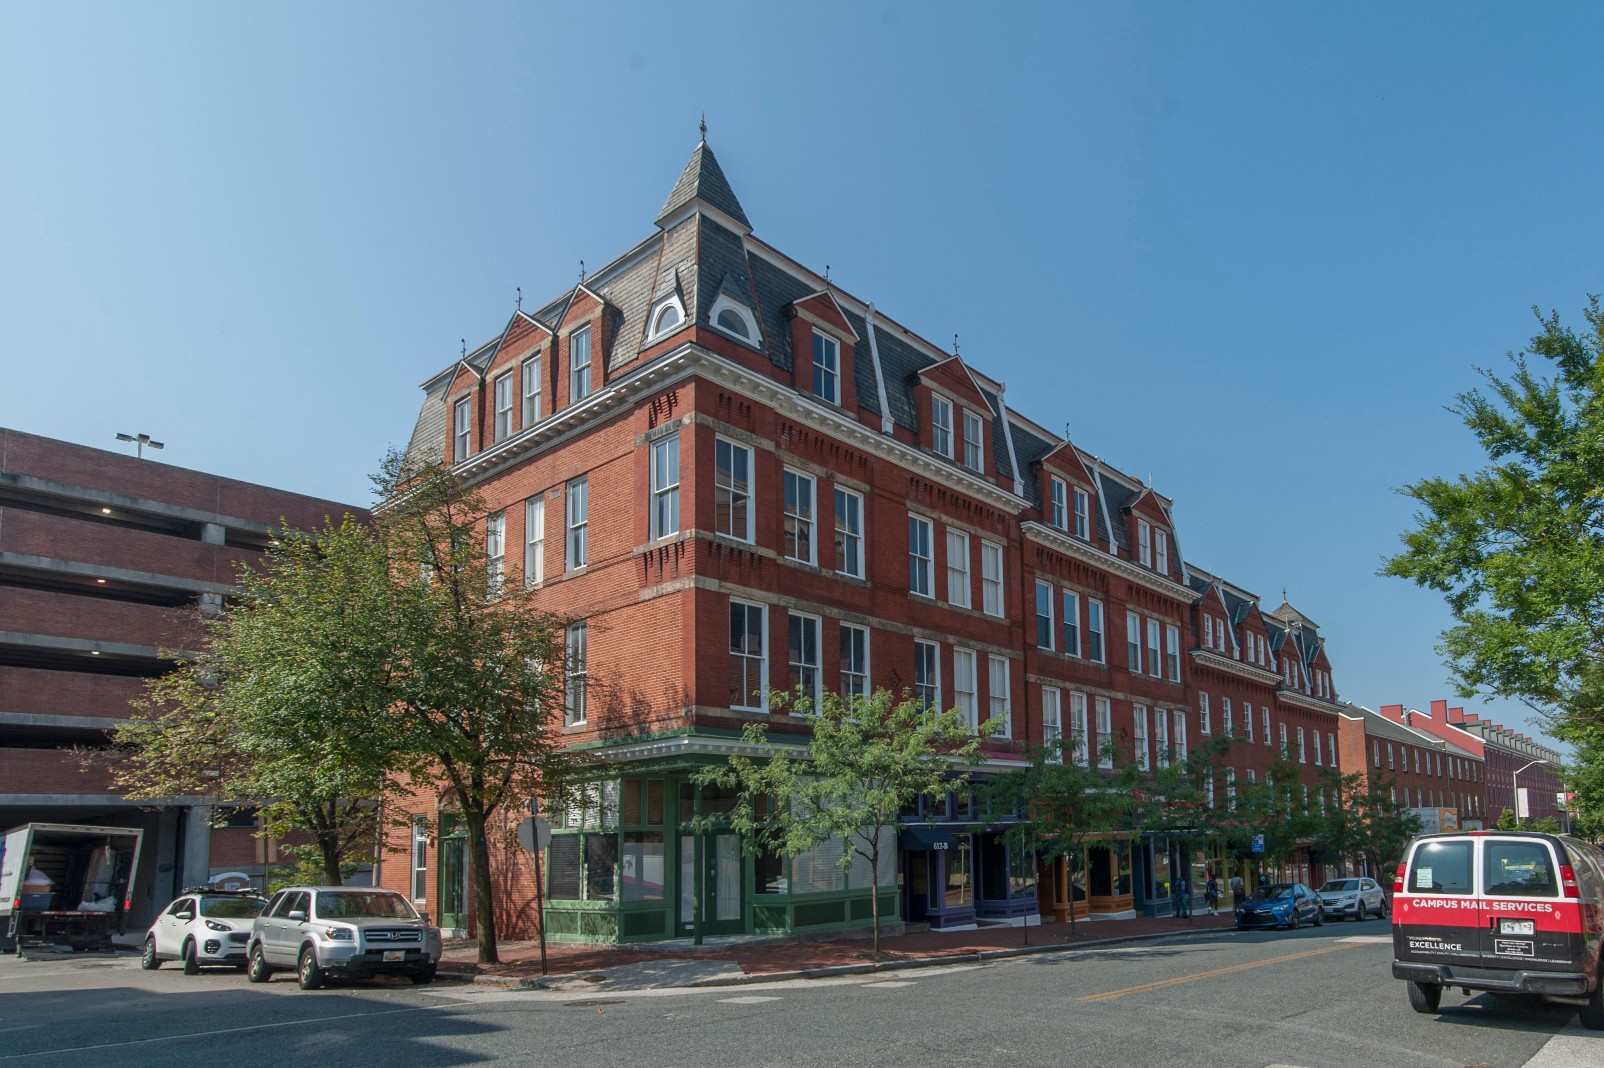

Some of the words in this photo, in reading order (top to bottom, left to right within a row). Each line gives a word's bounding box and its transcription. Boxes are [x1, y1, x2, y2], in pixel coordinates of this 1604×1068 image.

[1412, 899, 1458, 909] CAMPUS
[1461, 901, 1490, 910] MAIL
[1493, 902, 1553, 912] SERVICES
[1409, 941, 1462, 951] EXCELLENCE
